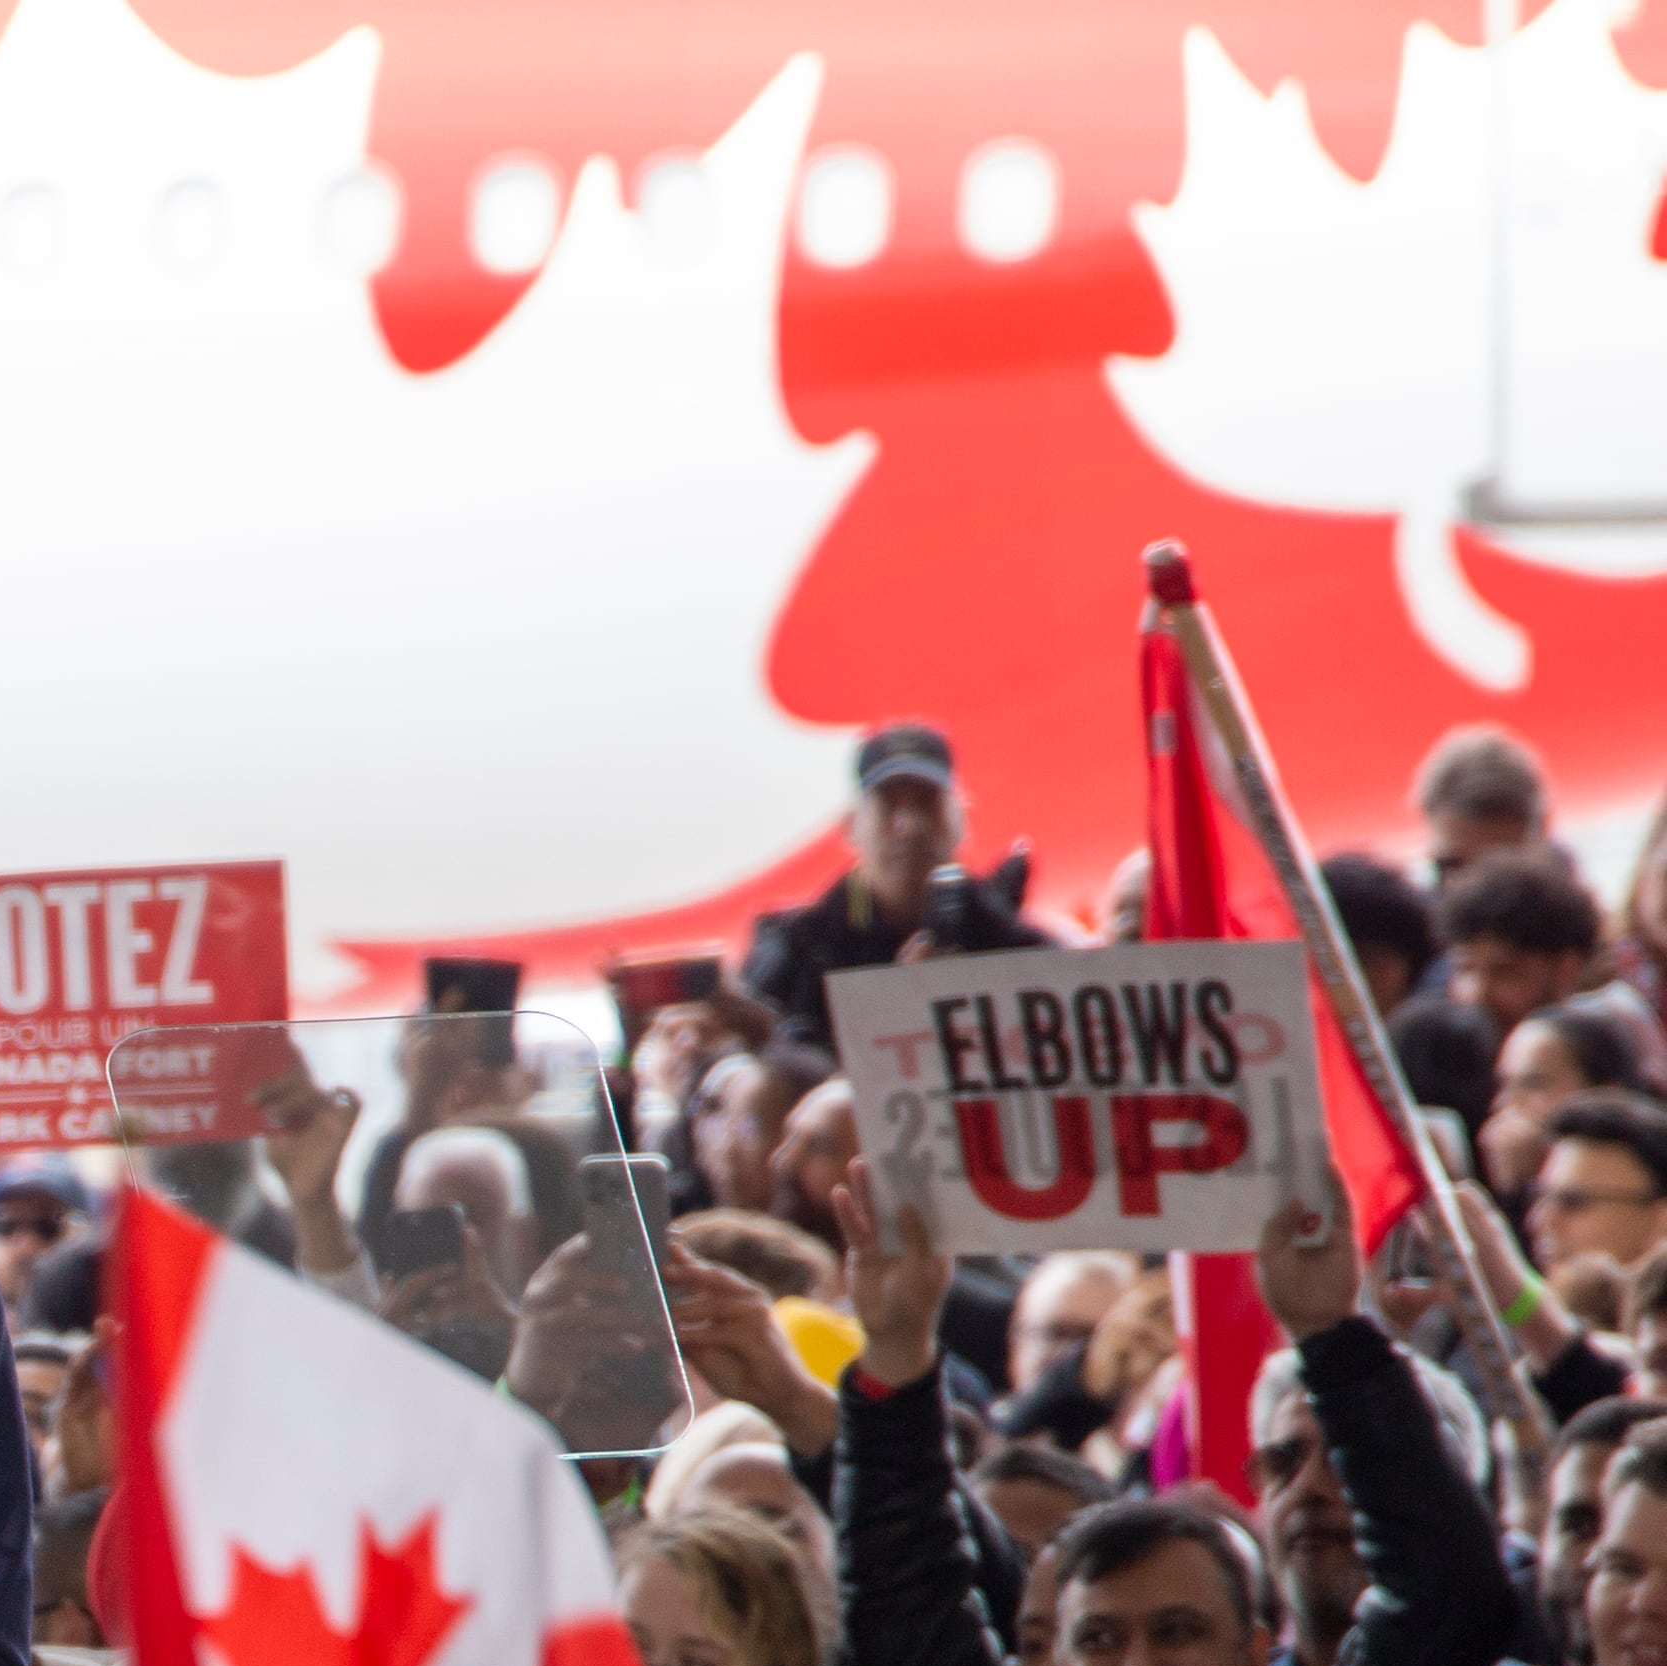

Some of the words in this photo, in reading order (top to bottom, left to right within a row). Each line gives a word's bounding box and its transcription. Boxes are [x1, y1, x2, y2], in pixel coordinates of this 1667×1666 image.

[99, 1012, 157, 1047] UN
[113, 1044, 216, 1080] FORT
[932, 979, 1241, 1091] ELBOWS
[954, 1094, 1251, 1224] UP
